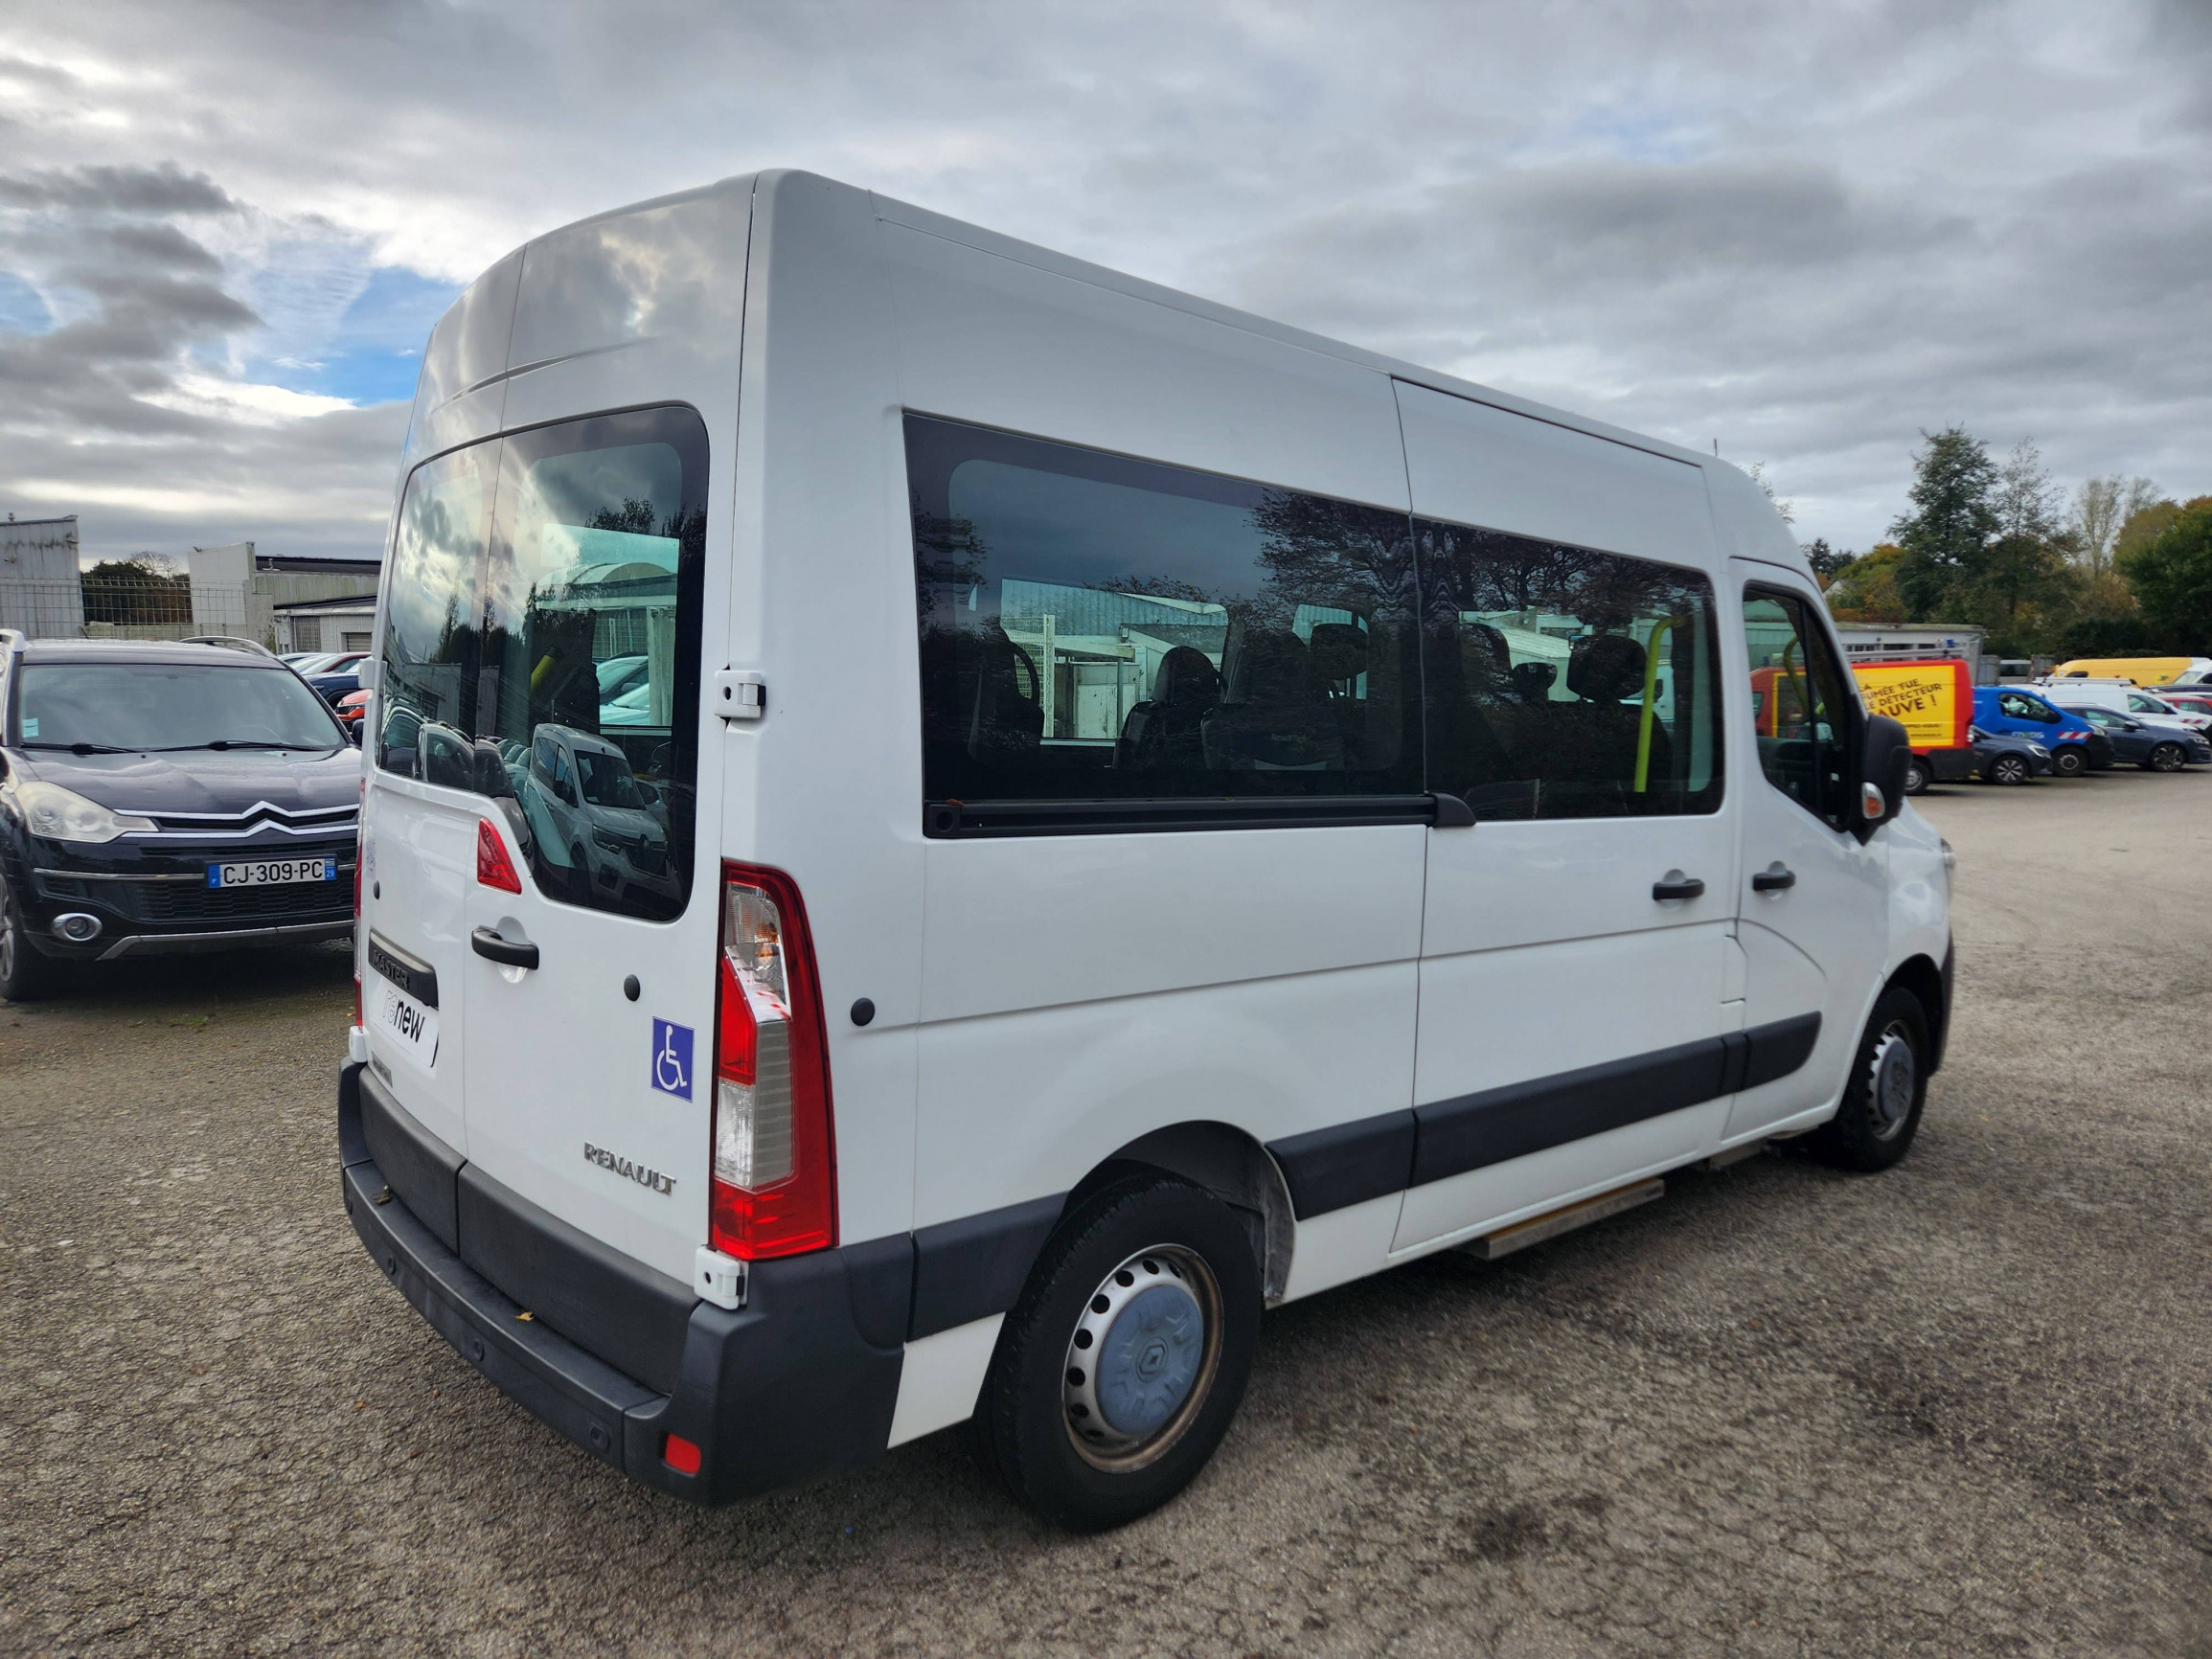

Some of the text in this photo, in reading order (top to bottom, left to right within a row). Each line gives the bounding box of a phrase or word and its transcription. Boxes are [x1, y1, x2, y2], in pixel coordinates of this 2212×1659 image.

[1898, 678, 1919, 690] TUE
[1869, 697, 1926, 716] AUVE
[224, 861, 323, 884] CJ-309-PC
[326, 869, 334, 878] 29
[373, 949, 410, 990] MASTER
[382, 989, 425, 1043] renew
[583, 1141, 676, 1197] RENAULT
